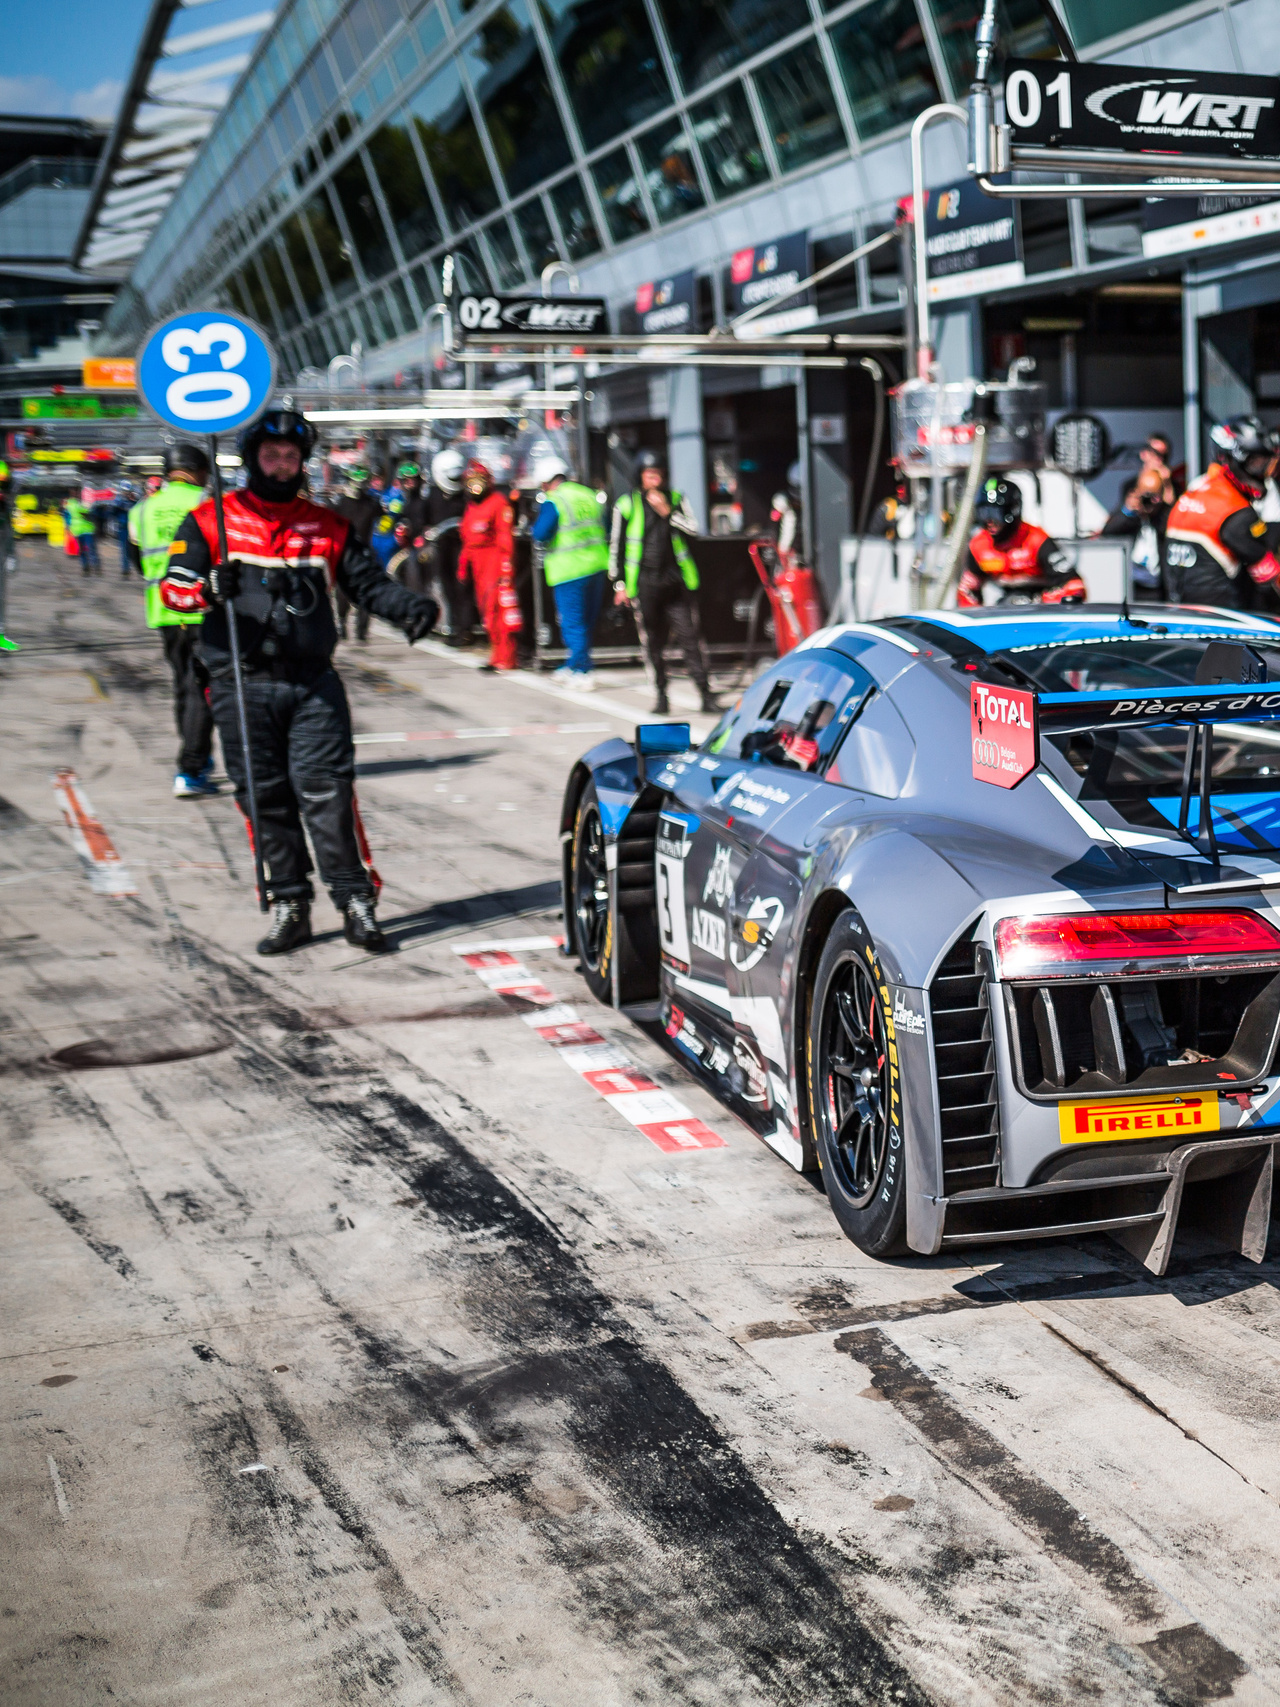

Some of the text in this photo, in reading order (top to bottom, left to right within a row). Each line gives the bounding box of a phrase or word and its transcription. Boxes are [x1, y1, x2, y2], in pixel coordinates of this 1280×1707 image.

[1006, 70, 1275, 130] 01 WRT
[459, 296, 501, 330] 02
[161, 321, 251, 421] 03
[977, 686, 1031, 729] TOTAL
[1110, 698, 1217, 716] Pièces
[660, 863, 673, 945] 3
[880, 985, 899, 1126] PIRELLI
[1074, 1098, 1202, 1134] PIRELLI
